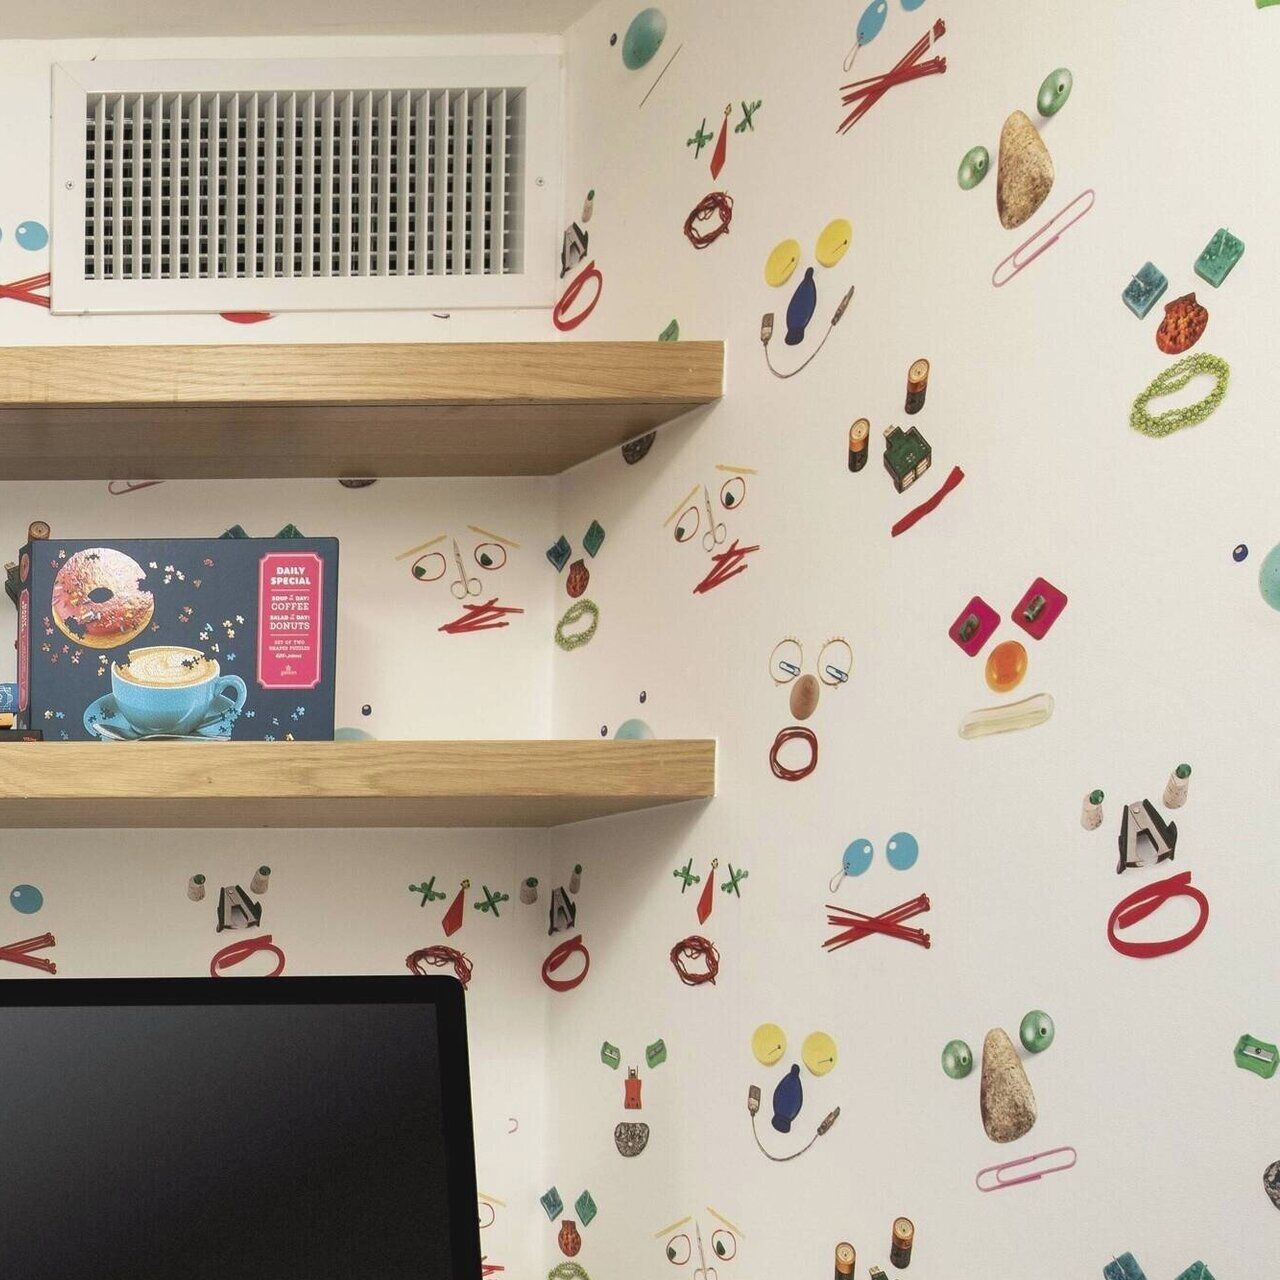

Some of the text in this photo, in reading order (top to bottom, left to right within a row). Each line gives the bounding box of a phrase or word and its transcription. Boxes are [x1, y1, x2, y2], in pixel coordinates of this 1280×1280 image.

[276, 566, 305, 574] DAILY
[270, 577, 311, 585] SPECIAL
[270, 622, 310, 630] DONUTS
